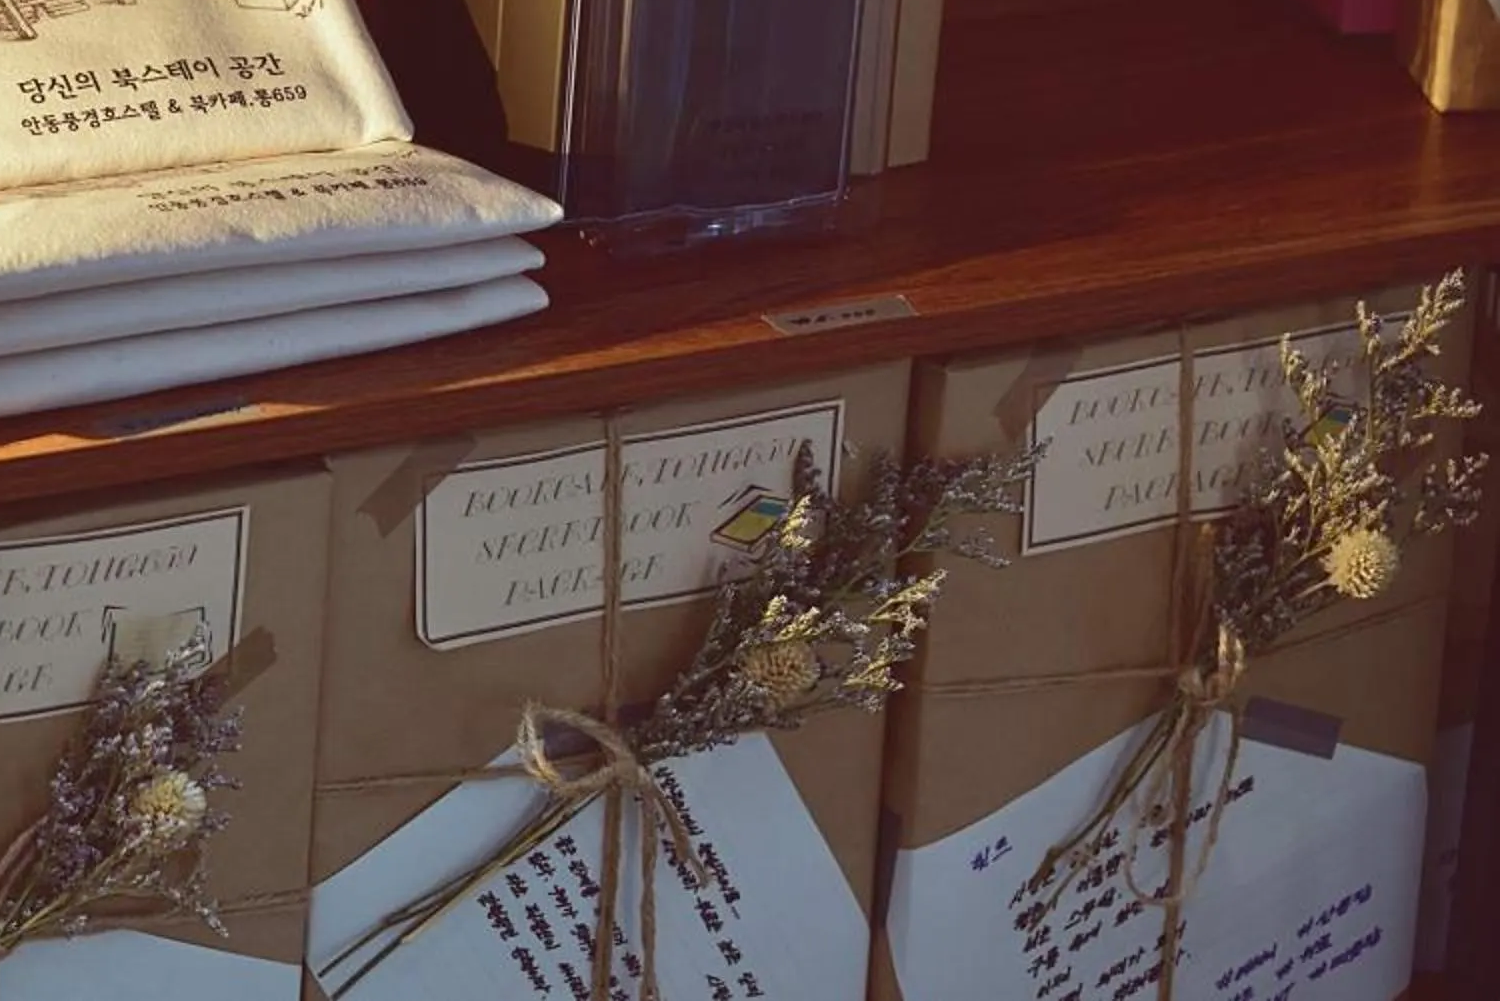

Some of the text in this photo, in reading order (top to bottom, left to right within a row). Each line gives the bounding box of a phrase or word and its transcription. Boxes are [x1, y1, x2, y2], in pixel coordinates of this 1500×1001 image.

[16, 52, 286, 104] 당신의 북스테이 공간
[20, 98, 162, 136] 안동풍경호스텔
[166, 98, 183, 115] &
